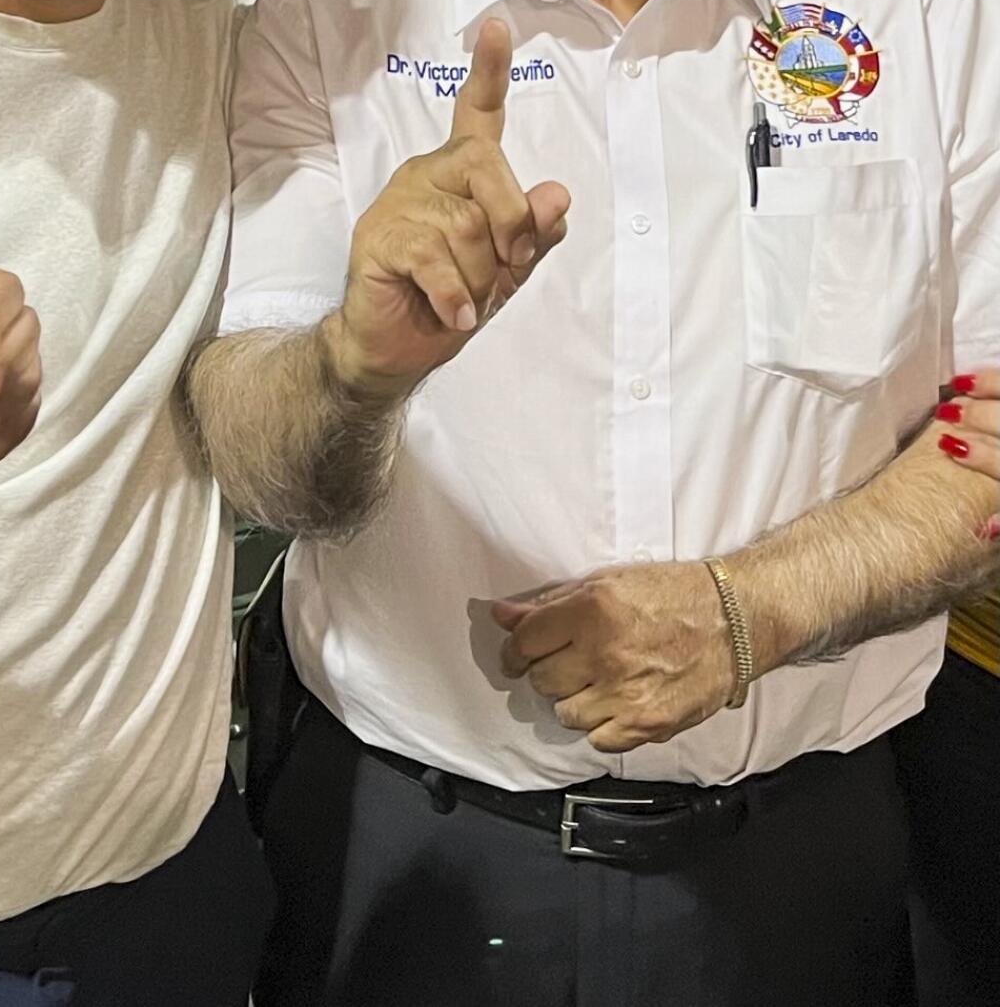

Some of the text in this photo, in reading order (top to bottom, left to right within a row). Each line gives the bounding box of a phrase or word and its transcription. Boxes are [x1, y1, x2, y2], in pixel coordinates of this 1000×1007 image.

[387, 54, 555, 82] Dr. Victor eviño
[770, 128, 879, 148] City of Laredo
